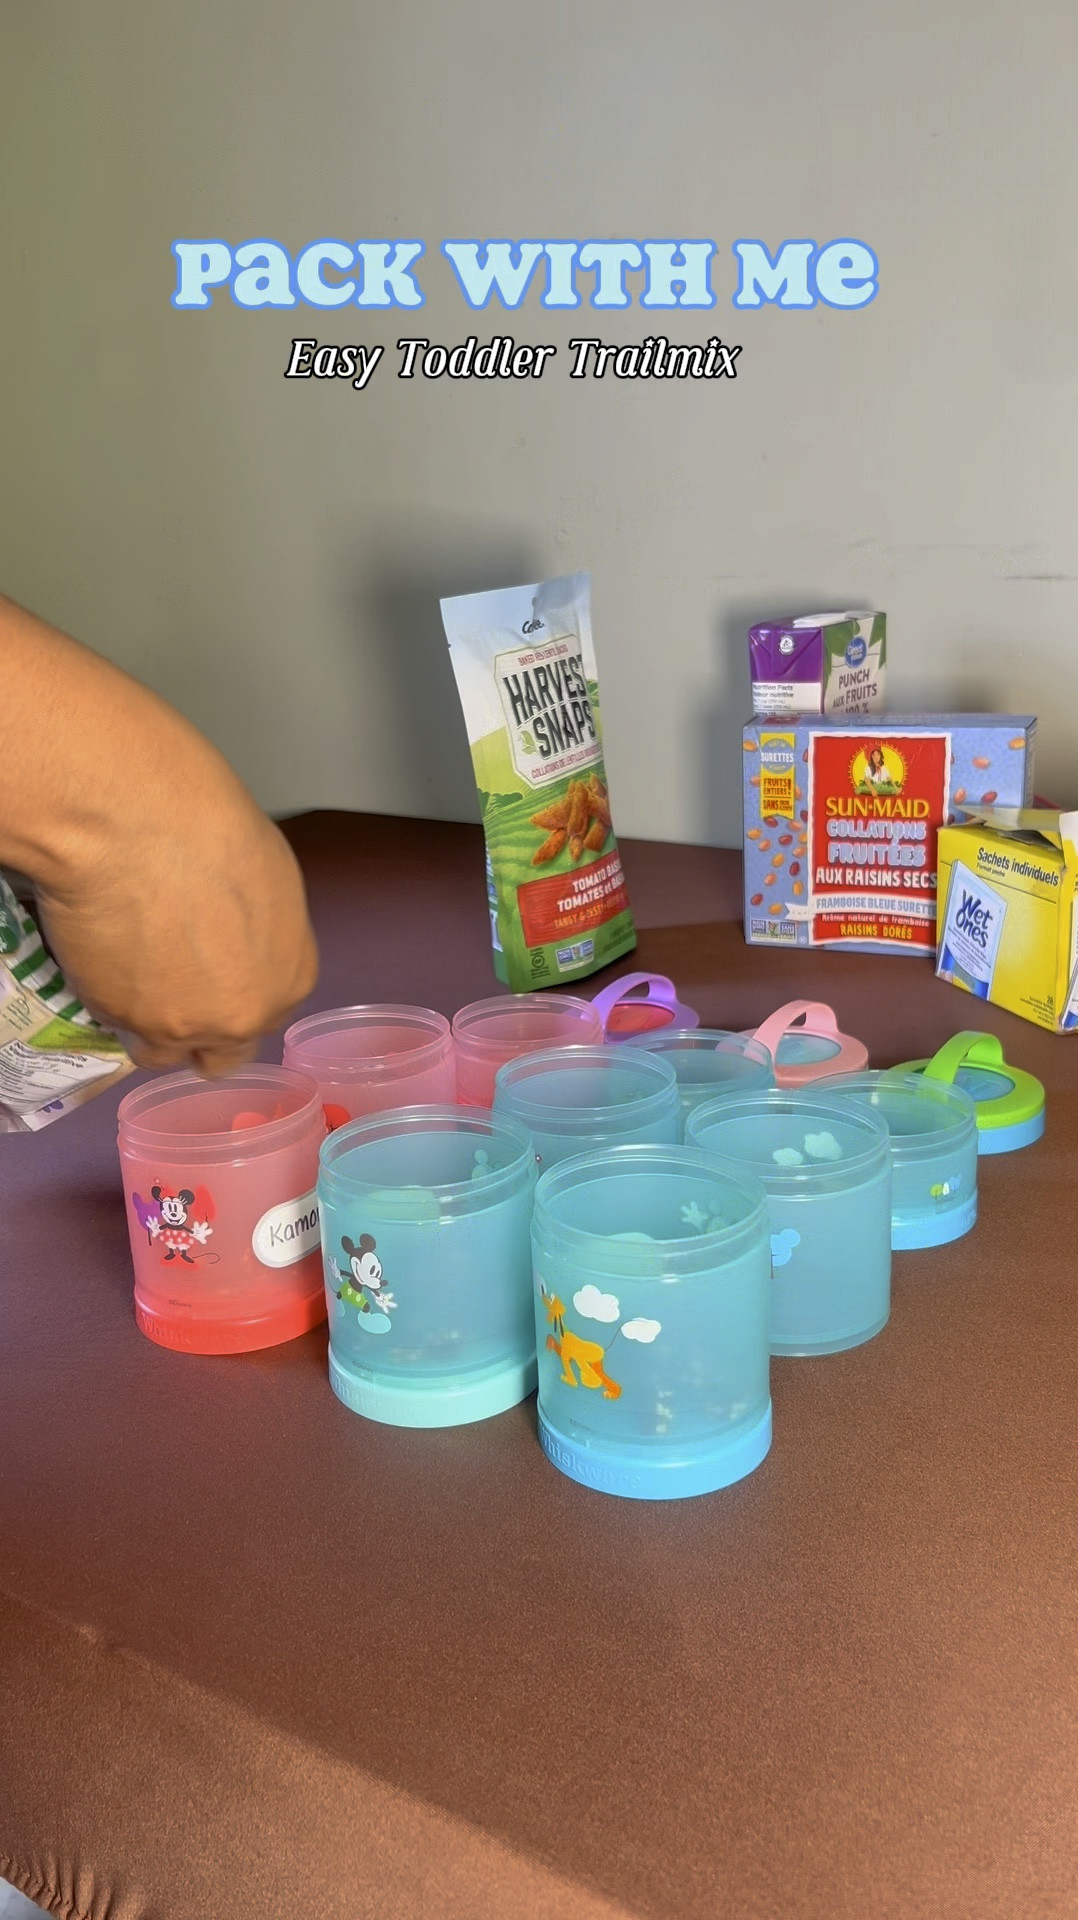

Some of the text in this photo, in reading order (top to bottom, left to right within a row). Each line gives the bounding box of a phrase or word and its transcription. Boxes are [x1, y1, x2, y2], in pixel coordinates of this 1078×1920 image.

[839, 668, 870, 689] PUNCH
[832, 682, 877, 709] AUX FRUITS
[532, 701, 596, 758] SNAPS
[761, 752, 794, 762] SURETTES
[826, 819, 927, 840] COLLATIONS
[828, 840, 926, 867] FRUITÉES
[815, 867, 937, 888] AUX RAISINS SECS
[977, 847, 1010, 870] Sachets
[1011, 857, 1059, 887] individuels
[572, 868, 607, 893] TOMATO
[557, 885, 605, 912] TOMATES
[816, 897, 866, 909] FRAMBOISE
[868, 898, 896, 911] BLEUE
[962, 888, 993, 930] Wet
[840, 923, 913, 939] RAISINS DORÉS
[848, 914, 875, 923] naturel
[879, 915, 889, 923] de
[891, 915, 930, 927] framboise
[956, 908, 989, 948] Ones
